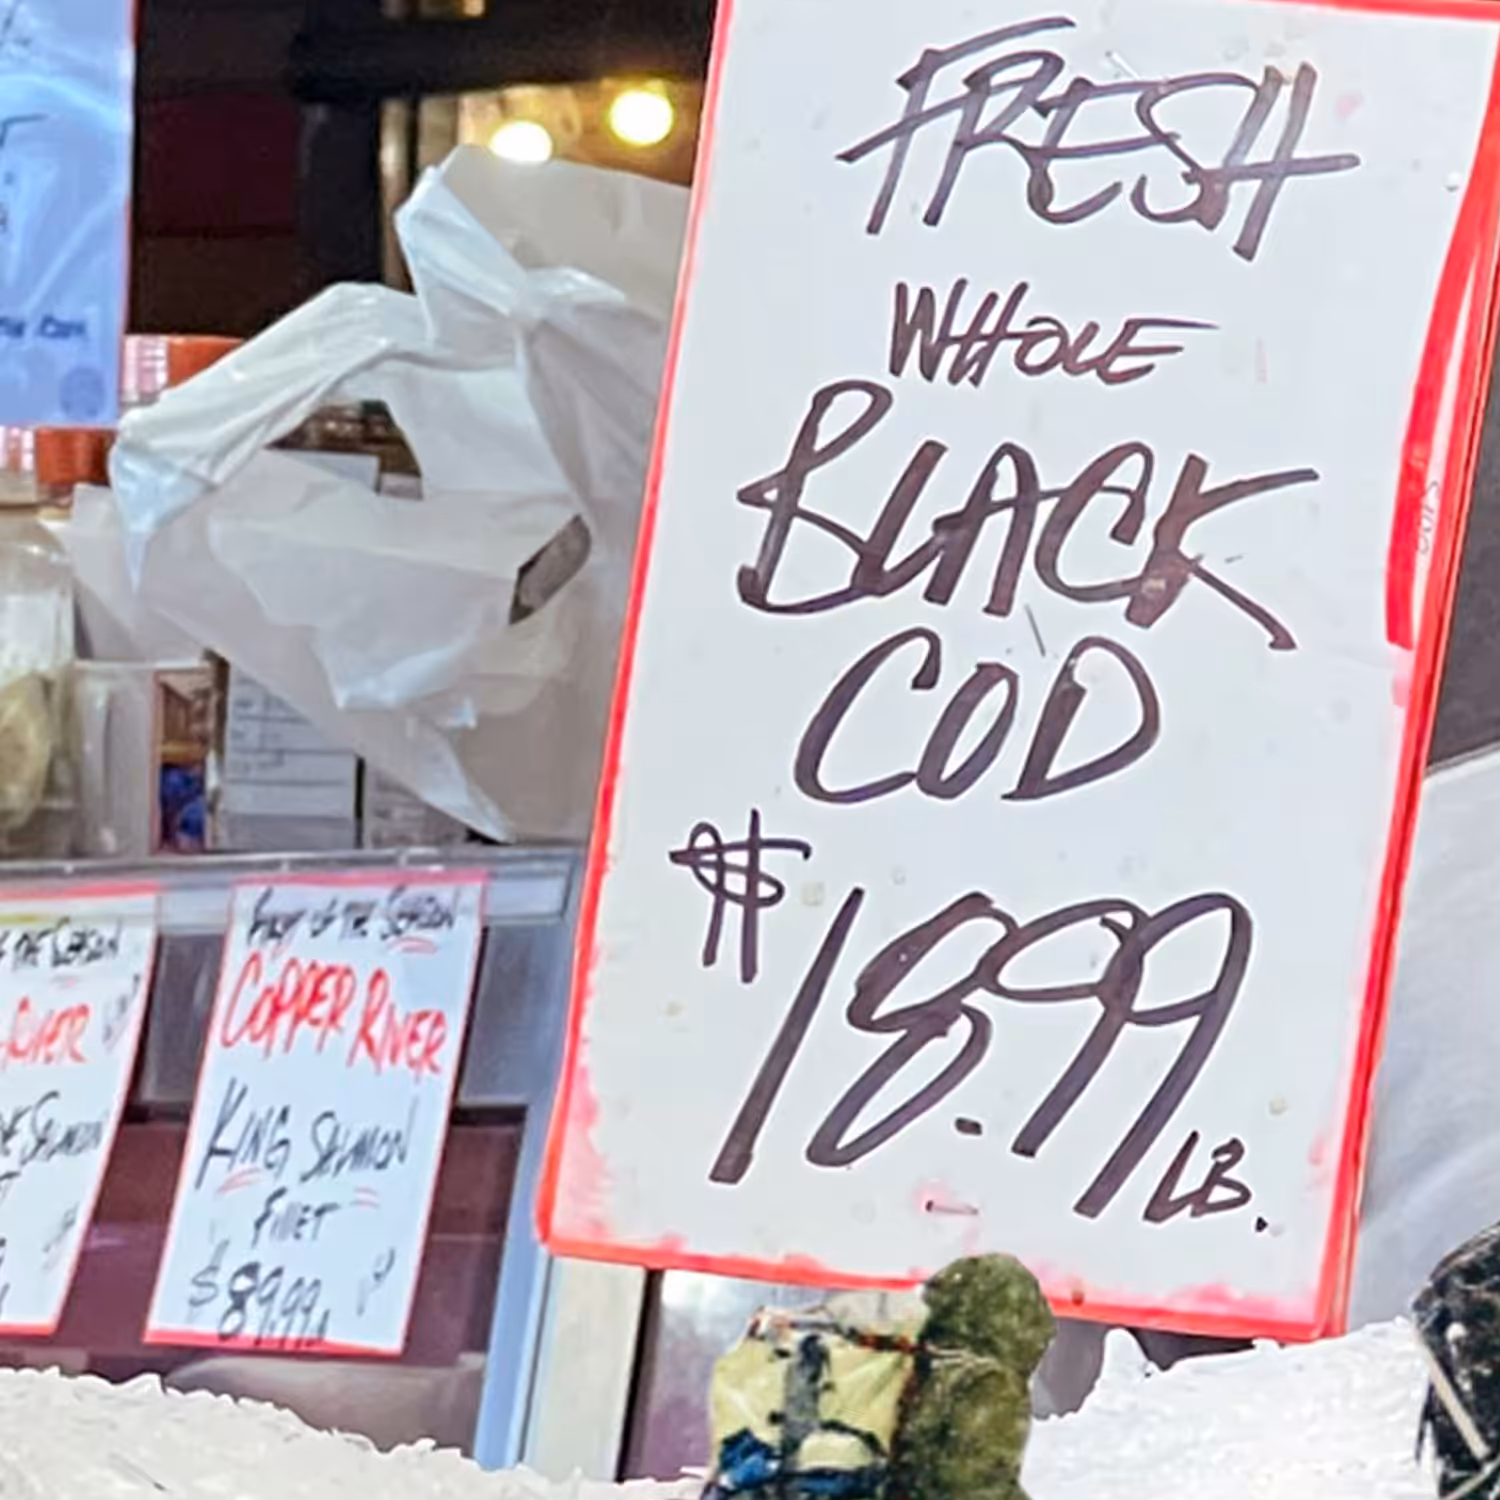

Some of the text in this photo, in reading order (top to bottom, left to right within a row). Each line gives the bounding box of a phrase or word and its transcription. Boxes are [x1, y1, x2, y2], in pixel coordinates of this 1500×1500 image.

[836, 16, 1362, 261] FRESH
[888, 278, 1220, 387] WHOLE
[736, 379, 1320, 651] BLACK
[794, 626, 1161, 804] COD
[221, 952, 357, 1060] COPPER
[346, 968, 448, 1083] RIVER
[195, 1077, 419, 1189] KING SALMON
